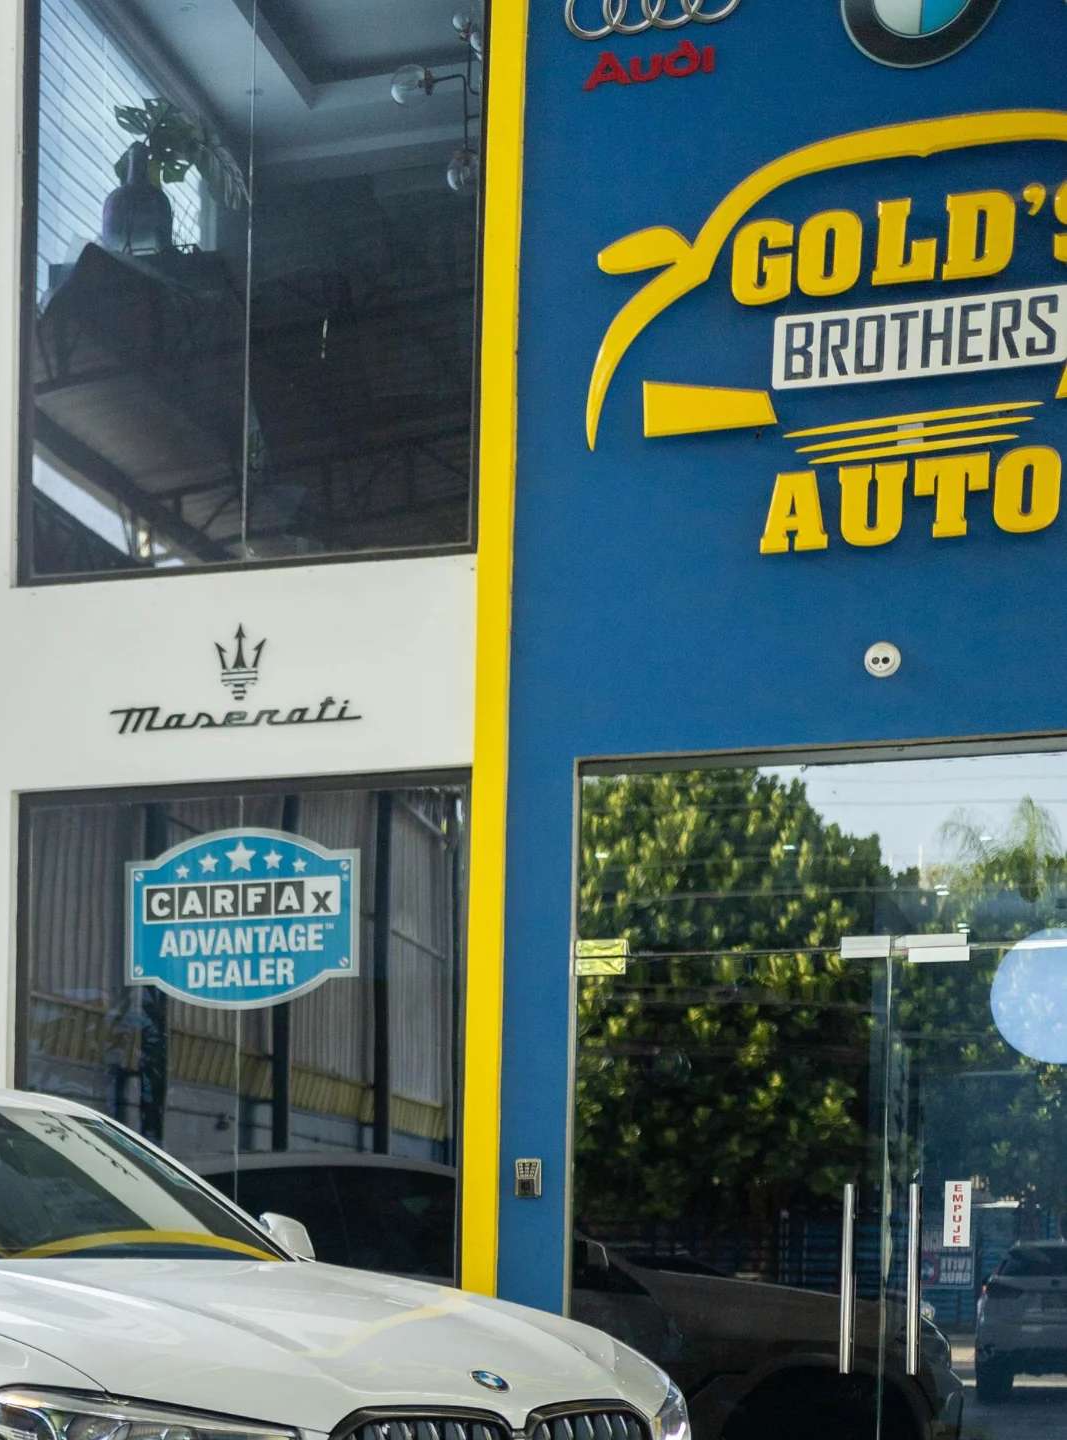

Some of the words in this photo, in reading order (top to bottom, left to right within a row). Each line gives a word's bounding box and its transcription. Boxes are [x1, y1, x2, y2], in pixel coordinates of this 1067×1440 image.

[731, 181, 1067, 306] GOLD'
[783, 293, 1059, 382] BROTHERS
[760, 445, 1062, 554] AUTO
[109, 697, 362, 735] Maserati
[150, 884, 332, 917] CARFAX
[187, 958, 295, 989] DEALER
[952, 1183, 964, 1244] EMPUJE
